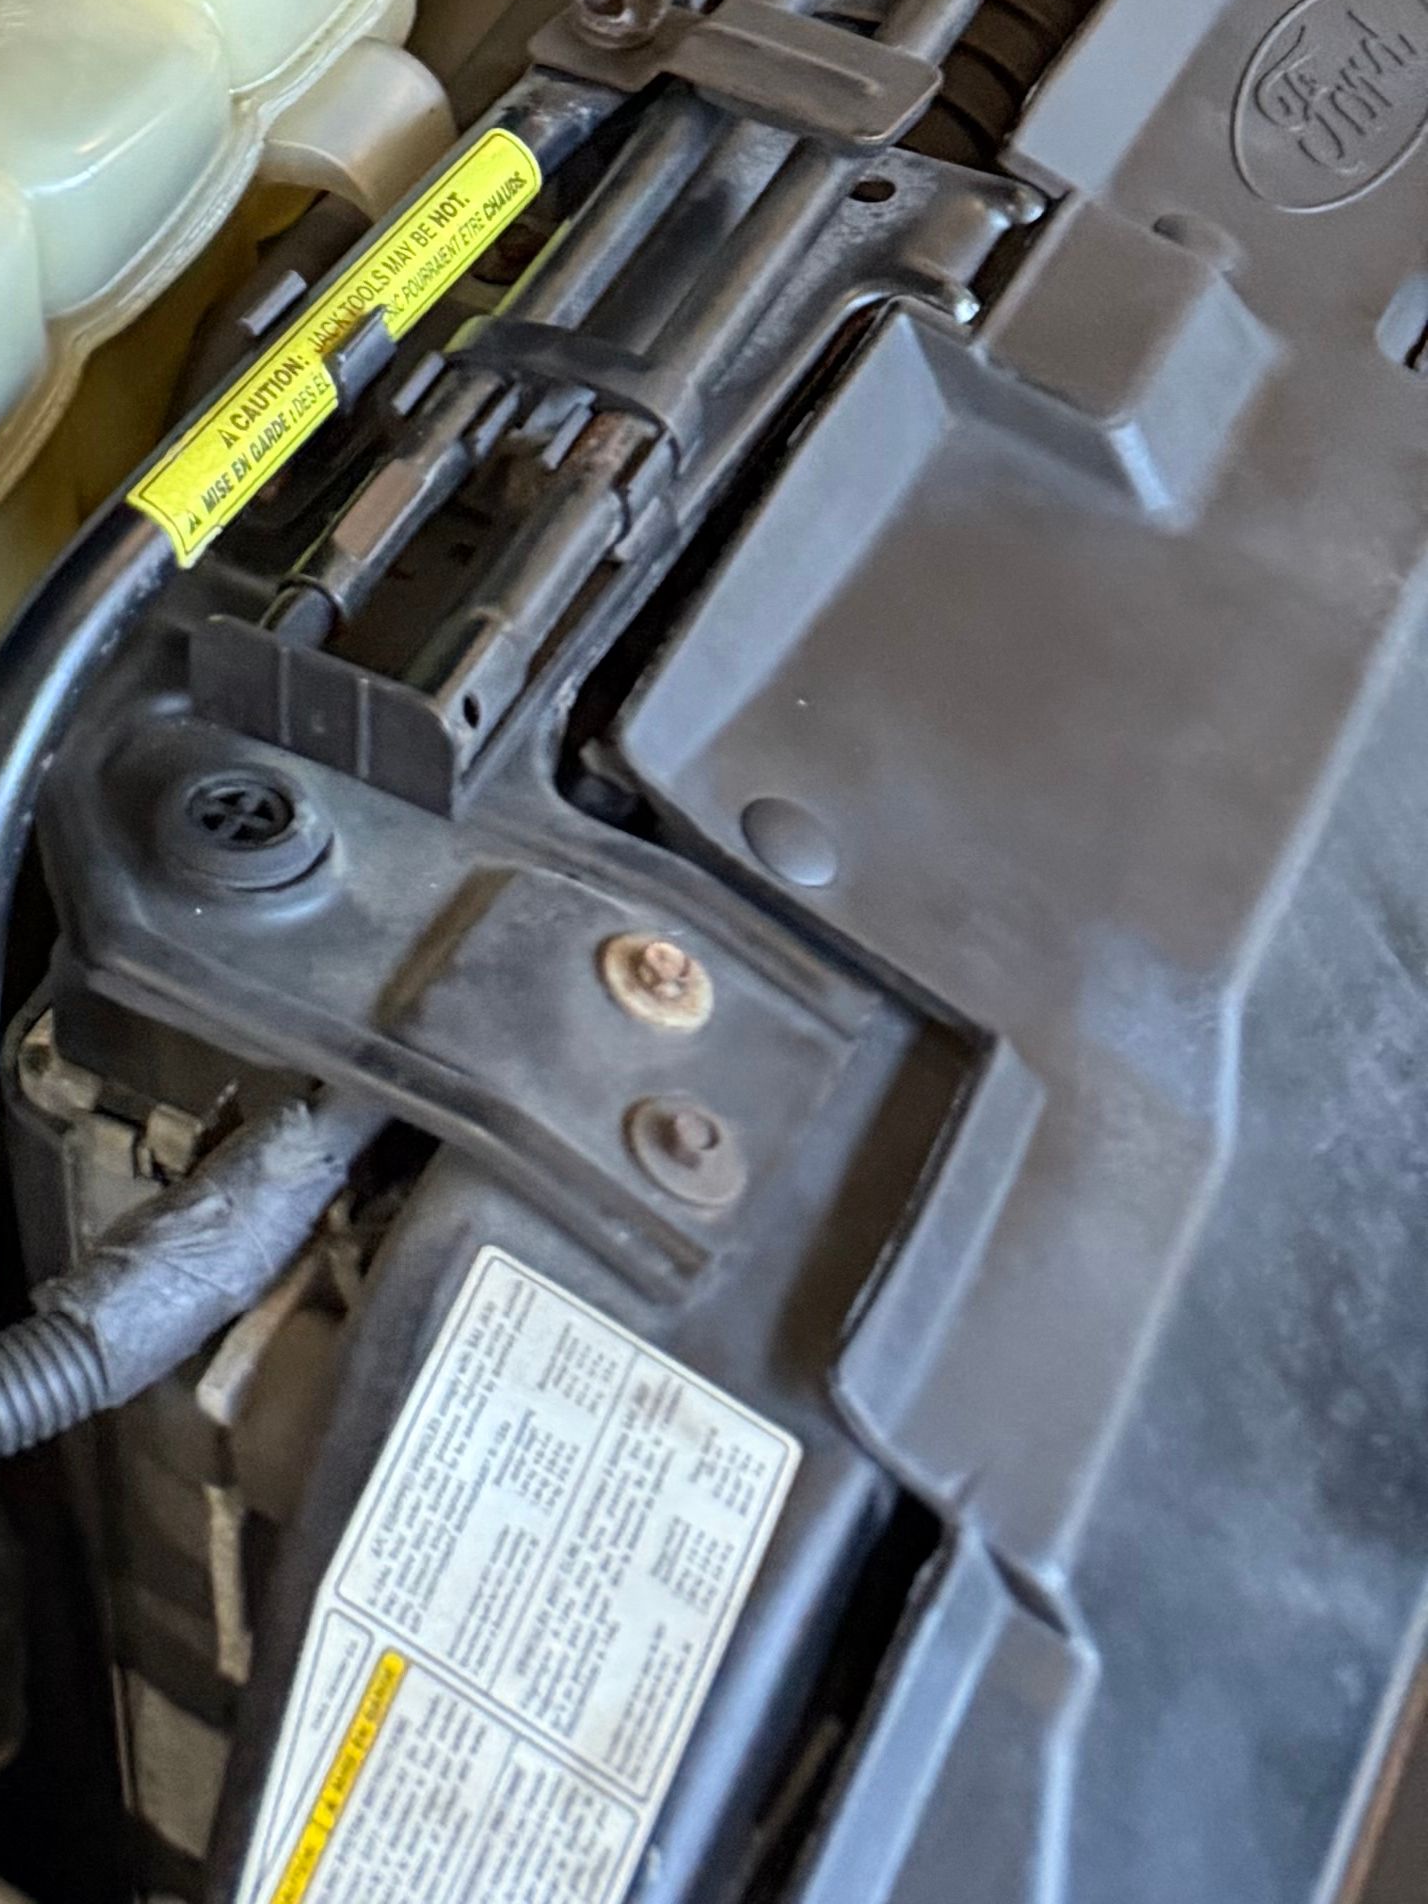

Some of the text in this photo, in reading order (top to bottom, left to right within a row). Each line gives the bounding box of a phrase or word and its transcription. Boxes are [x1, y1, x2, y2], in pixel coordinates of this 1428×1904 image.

[200, 476, 233, 515] MISE
[230, 457, 253, 484] EN
[247, 414, 293, 465] GARDE
[403, 240, 463, 301] POURRAIENT
[230, 353, 311, 431] CAUTION:
[312, 313, 353, 355] JACK
[343, 268, 392, 319] TOOLS
[382, 244, 418, 279] MAY
[411, 223, 439, 249] BE
[432, 191, 472, 230] HOT.
